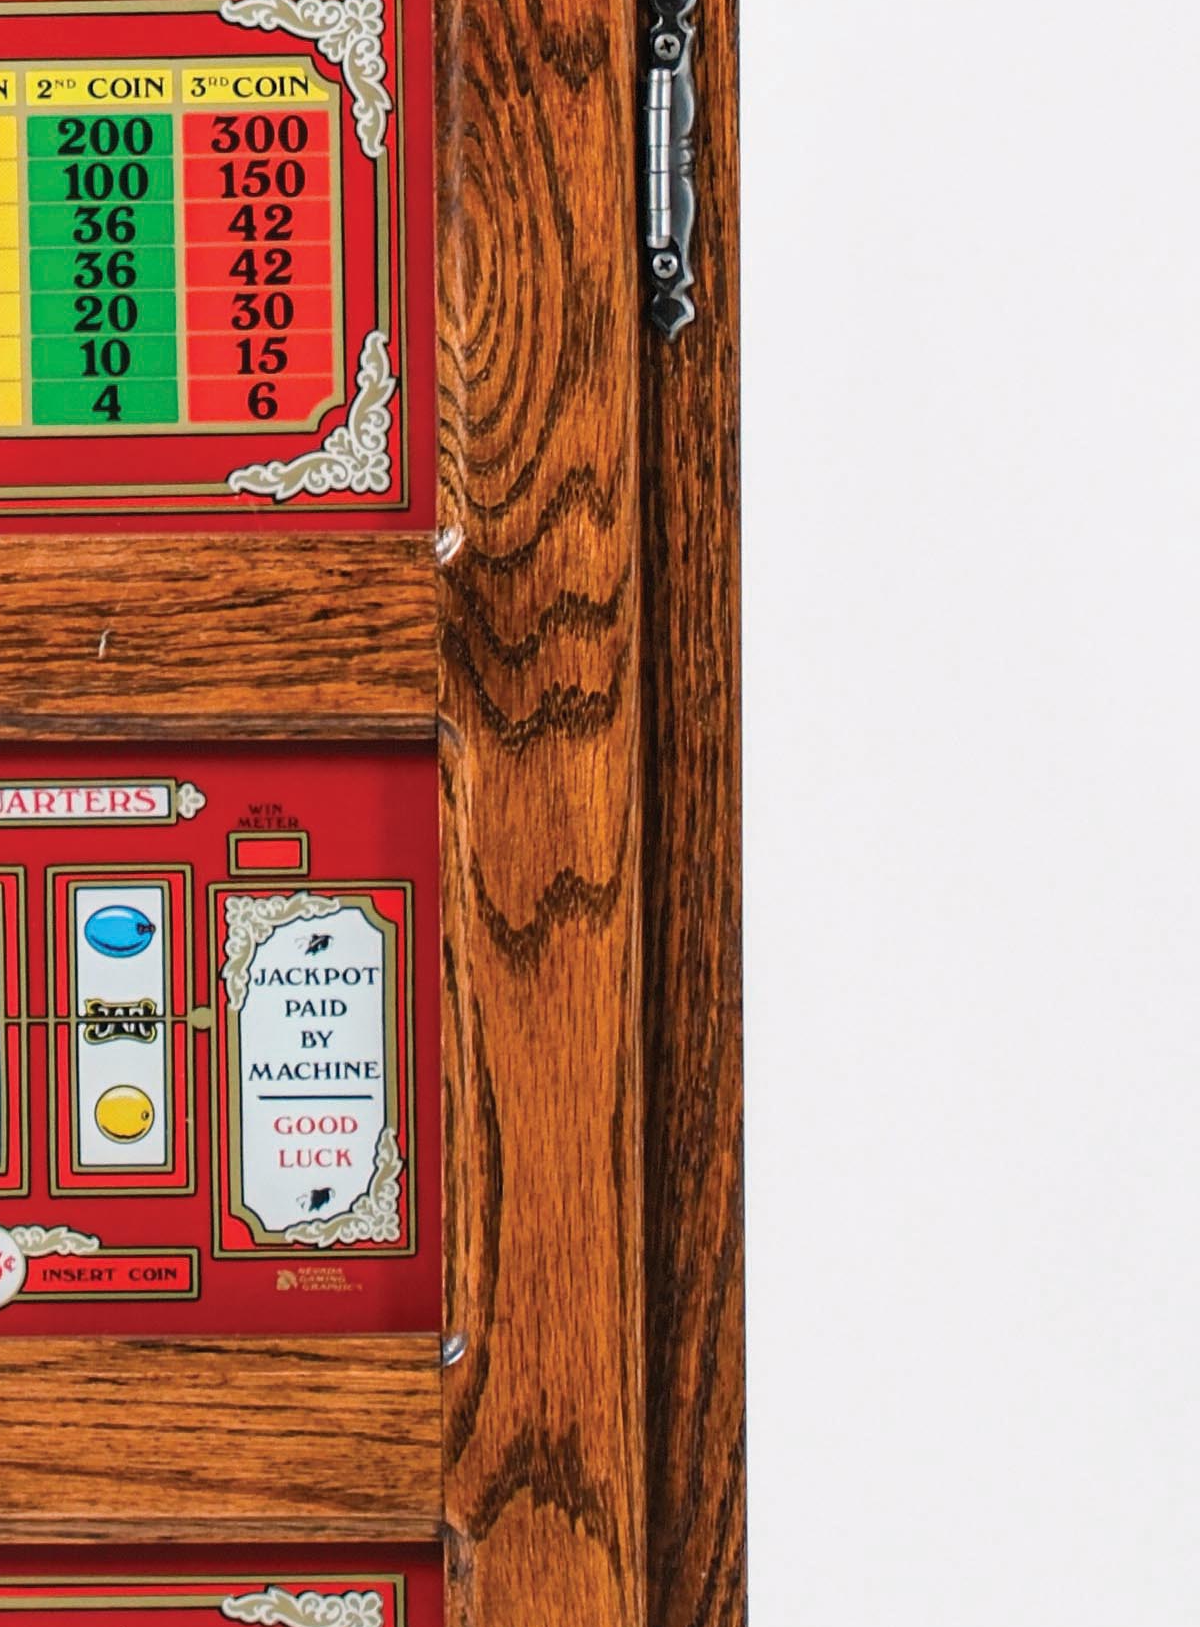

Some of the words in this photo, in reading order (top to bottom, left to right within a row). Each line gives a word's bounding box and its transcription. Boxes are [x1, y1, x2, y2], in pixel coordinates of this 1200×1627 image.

[87, 76, 165, 100] COIN
[231, 74, 311, 98] COIN
[56, 117, 154, 156] 200
[210, 115, 309, 154] 300
[63, 162, 149, 201] 100
[218, 159, 306, 199] 150
[73, 205, 137, 244] 36
[228, 203, 294, 241] 42
[73, 250, 138, 289] 36
[229, 247, 294, 286] 42
[73, 294, 138, 333] 20
[231, 291, 295, 330] 30
[80, 338, 131, 377] 10
[236, 336, 290, 375] 15
[92, 383, 121, 422] 4
[247, 381, 279, 420] 6
[248, 803, 283, 815] WIN
[237, 816, 299, 828] METER
[253, 967, 380, 986] JACKPOT
[285, 998, 348, 1017] PAID
[300, 1030, 334, 1049] BY
[248, 1061, 381, 1081] MACHINE
[273, 1116, 358, 1135] GOOD
[278, 1149, 353, 1168] LUCK
[42, 1267, 116, 1282] INSERT
[128, 1267, 178, 1281] COIN
